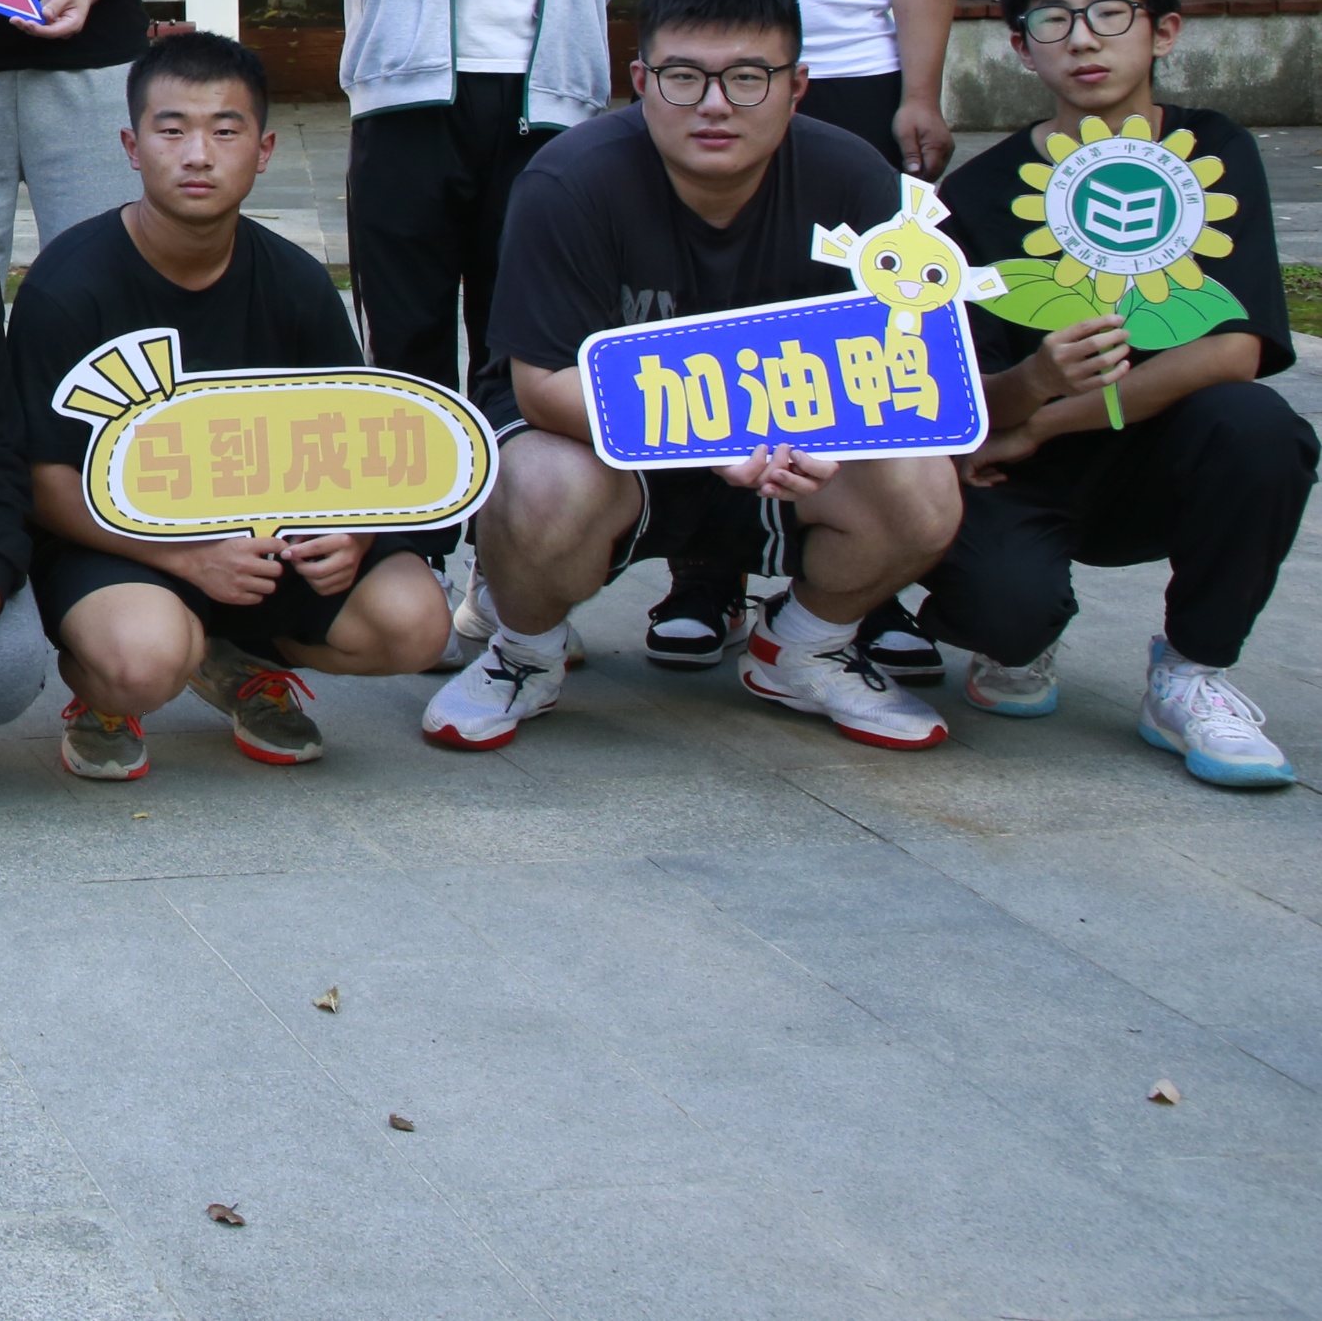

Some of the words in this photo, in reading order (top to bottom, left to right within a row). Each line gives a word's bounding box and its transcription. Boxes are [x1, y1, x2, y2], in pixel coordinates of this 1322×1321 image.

[1054, 143, 1200, 205] 合肥市第一中学教育集团
[1054, 224, 1188, 272] 合肥市第二十八中学
[634, 327, 940, 448] 加油鸭
[134, 408, 428, 500] 马到成功
